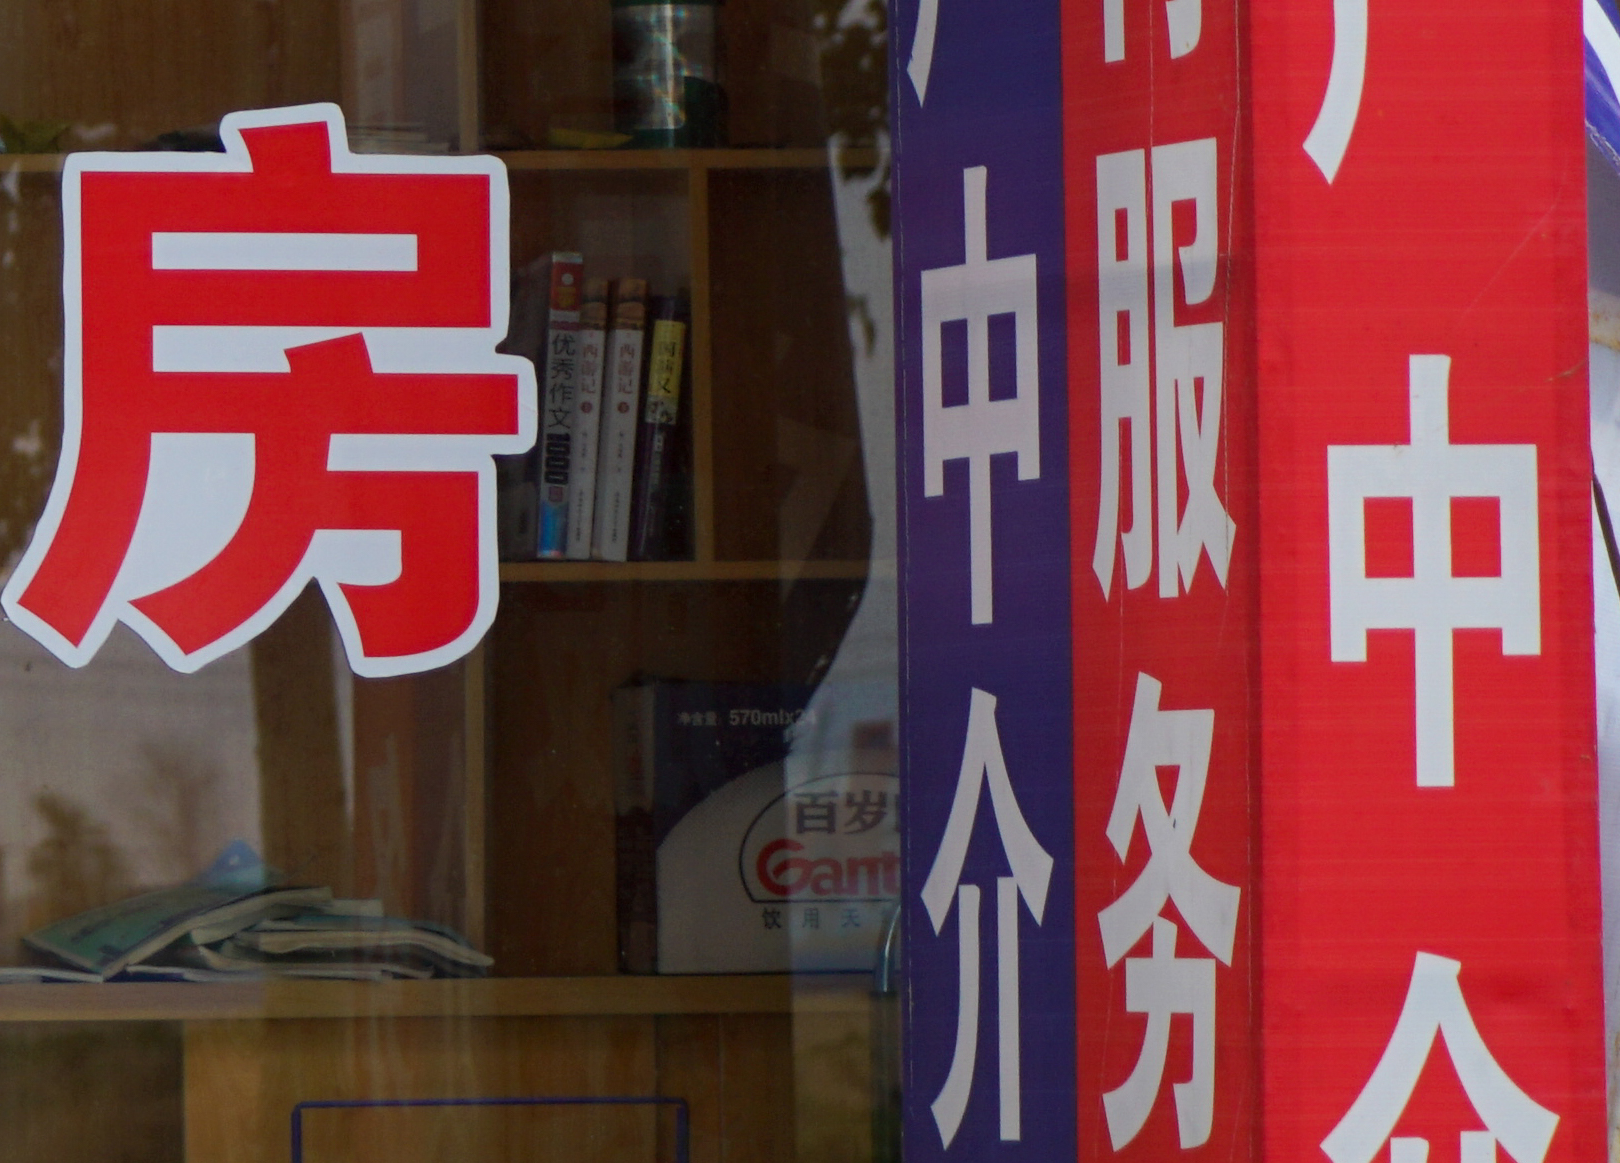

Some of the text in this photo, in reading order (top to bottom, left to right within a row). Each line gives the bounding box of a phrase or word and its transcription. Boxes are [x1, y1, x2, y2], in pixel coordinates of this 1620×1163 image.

[794, 789, 900, 835] 百岁
[760, 906, 896, 931] 饮用天
